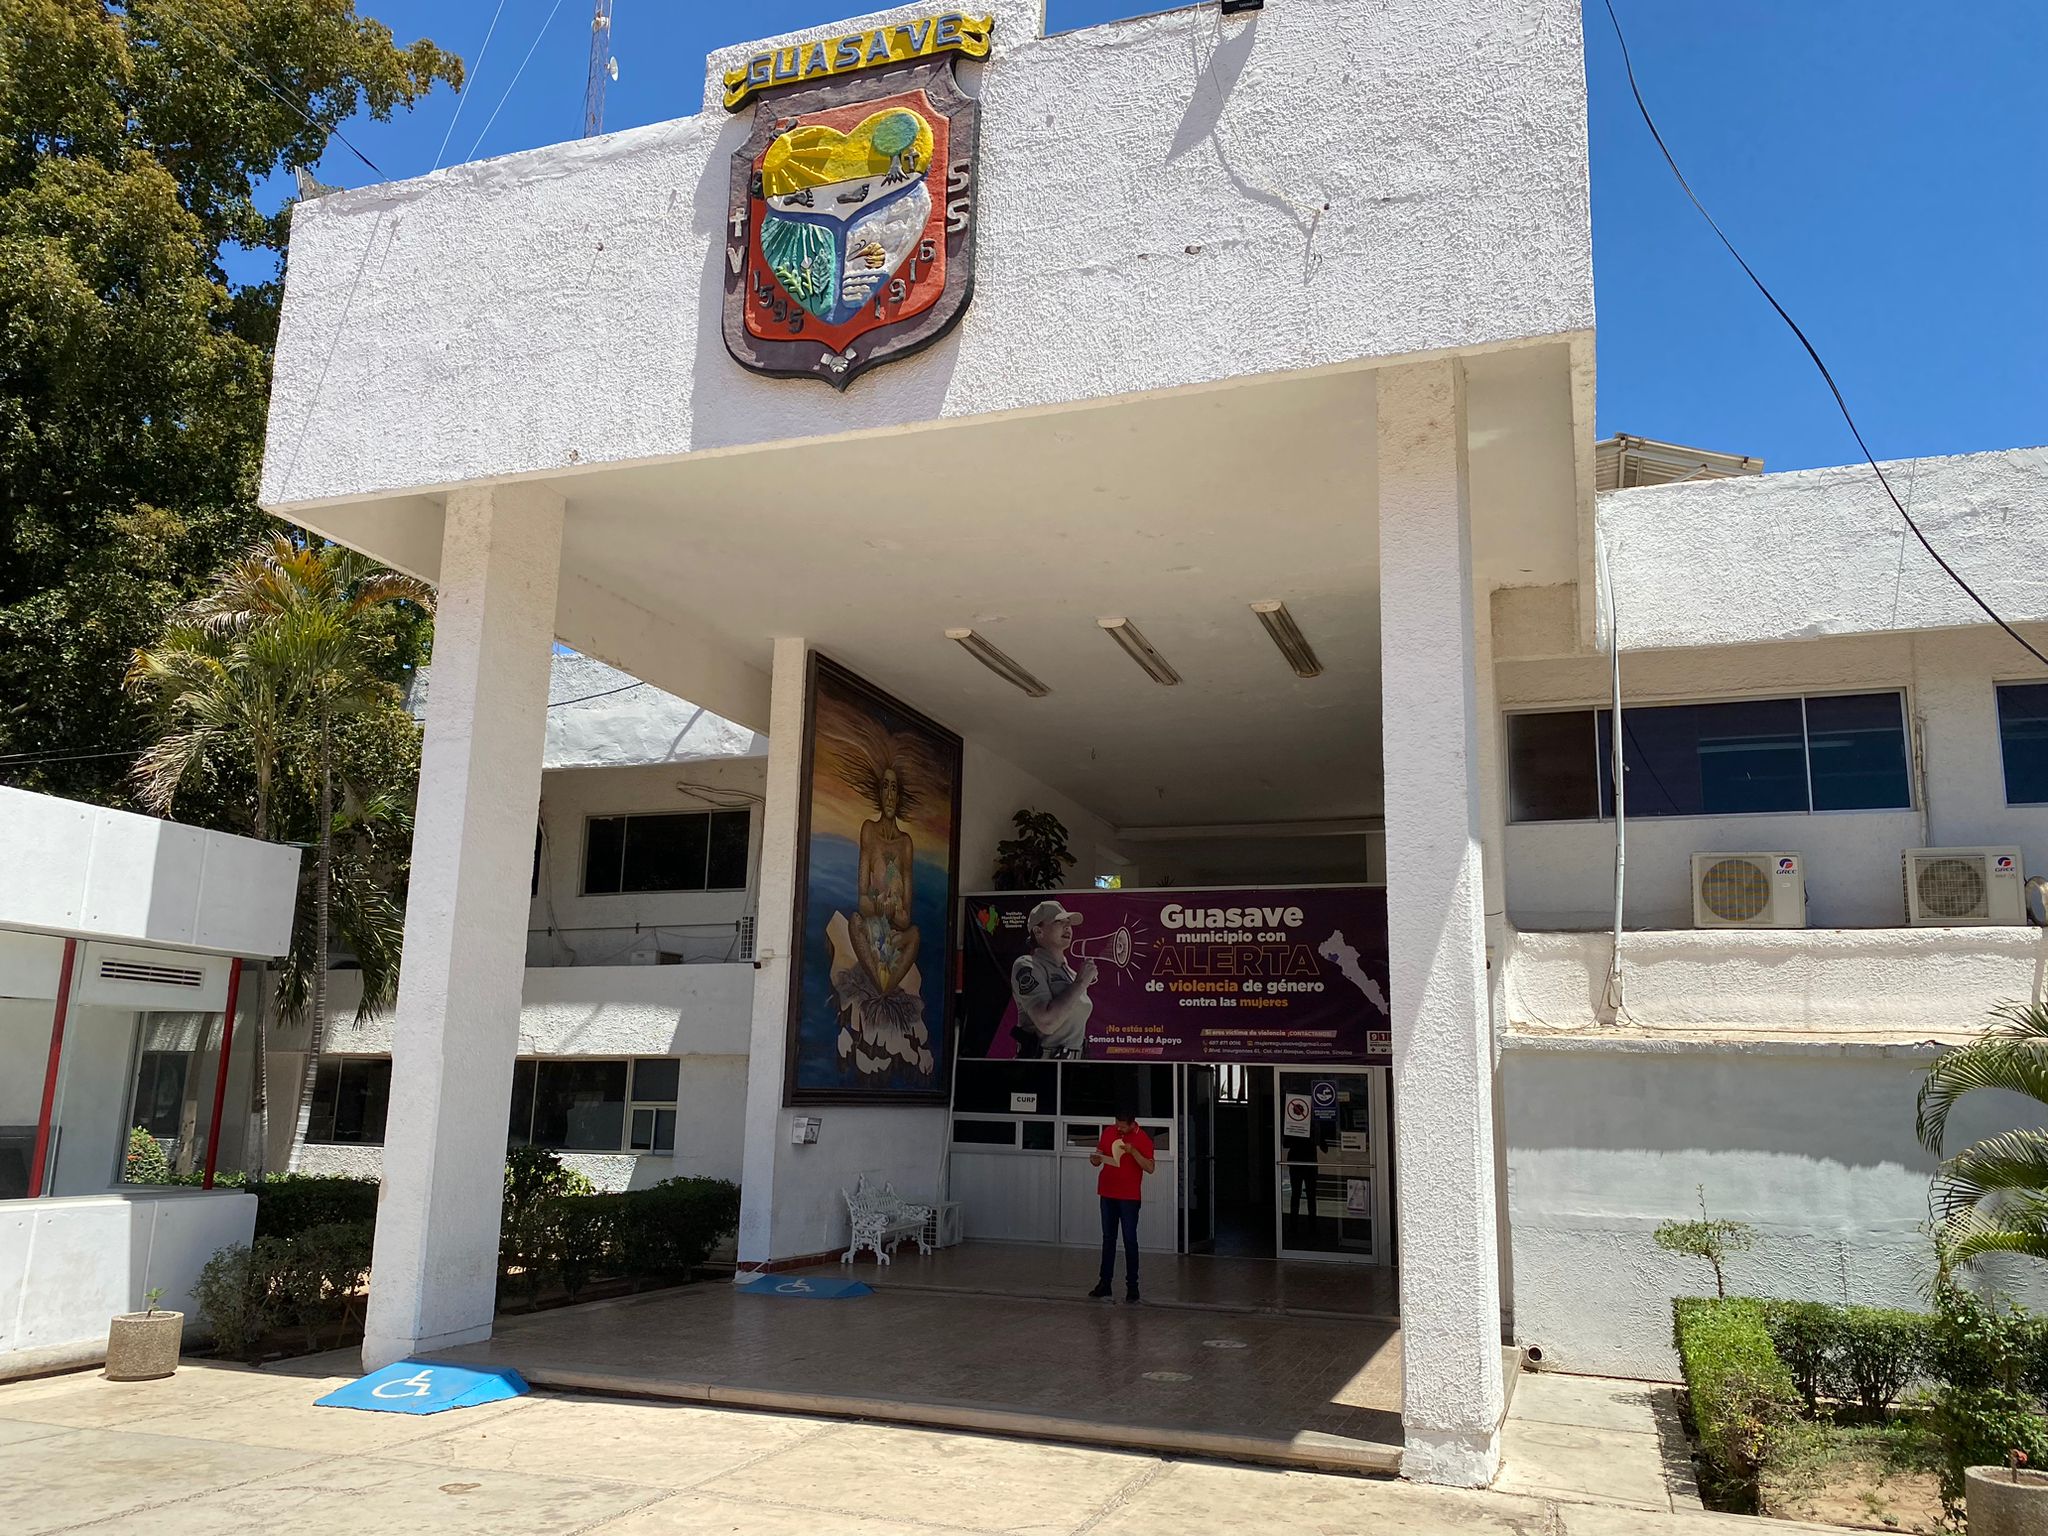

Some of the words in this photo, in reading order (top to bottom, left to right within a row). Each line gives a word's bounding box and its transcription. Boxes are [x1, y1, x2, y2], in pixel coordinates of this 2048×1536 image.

[748, 13, 963, 87] GUASAVE
[1160, 903, 1304, 929] Guasave
[1176, 930, 1253, 944] municipio
[1257, 931, 1287, 942] con
[1151, 944, 1320, 976] ALERTA
[1145, 979, 1164, 992] de
[1168, 979, 1239, 992] violencia
[1242, 979, 1263, 992] de
[1267, 979, 1325, 994] género
[1179, 998, 1217, 1007] contra
[1220, 997, 1237, 1007] las
[1240, 997, 1289, 1009] mujeres
[1106, 1024, 1120, 1034] ¡No
[1121, 1024, 1143, 1033] estás
[1144, 1024, 1164, 1033] sola!
[1088, 1035, 1115, 1043] Somos
[1126, 1035, 1142, 1043] Red
[1143, 1036, 1154, 1044] de
[1155, 1036, 1182, 1046] Apoyo
